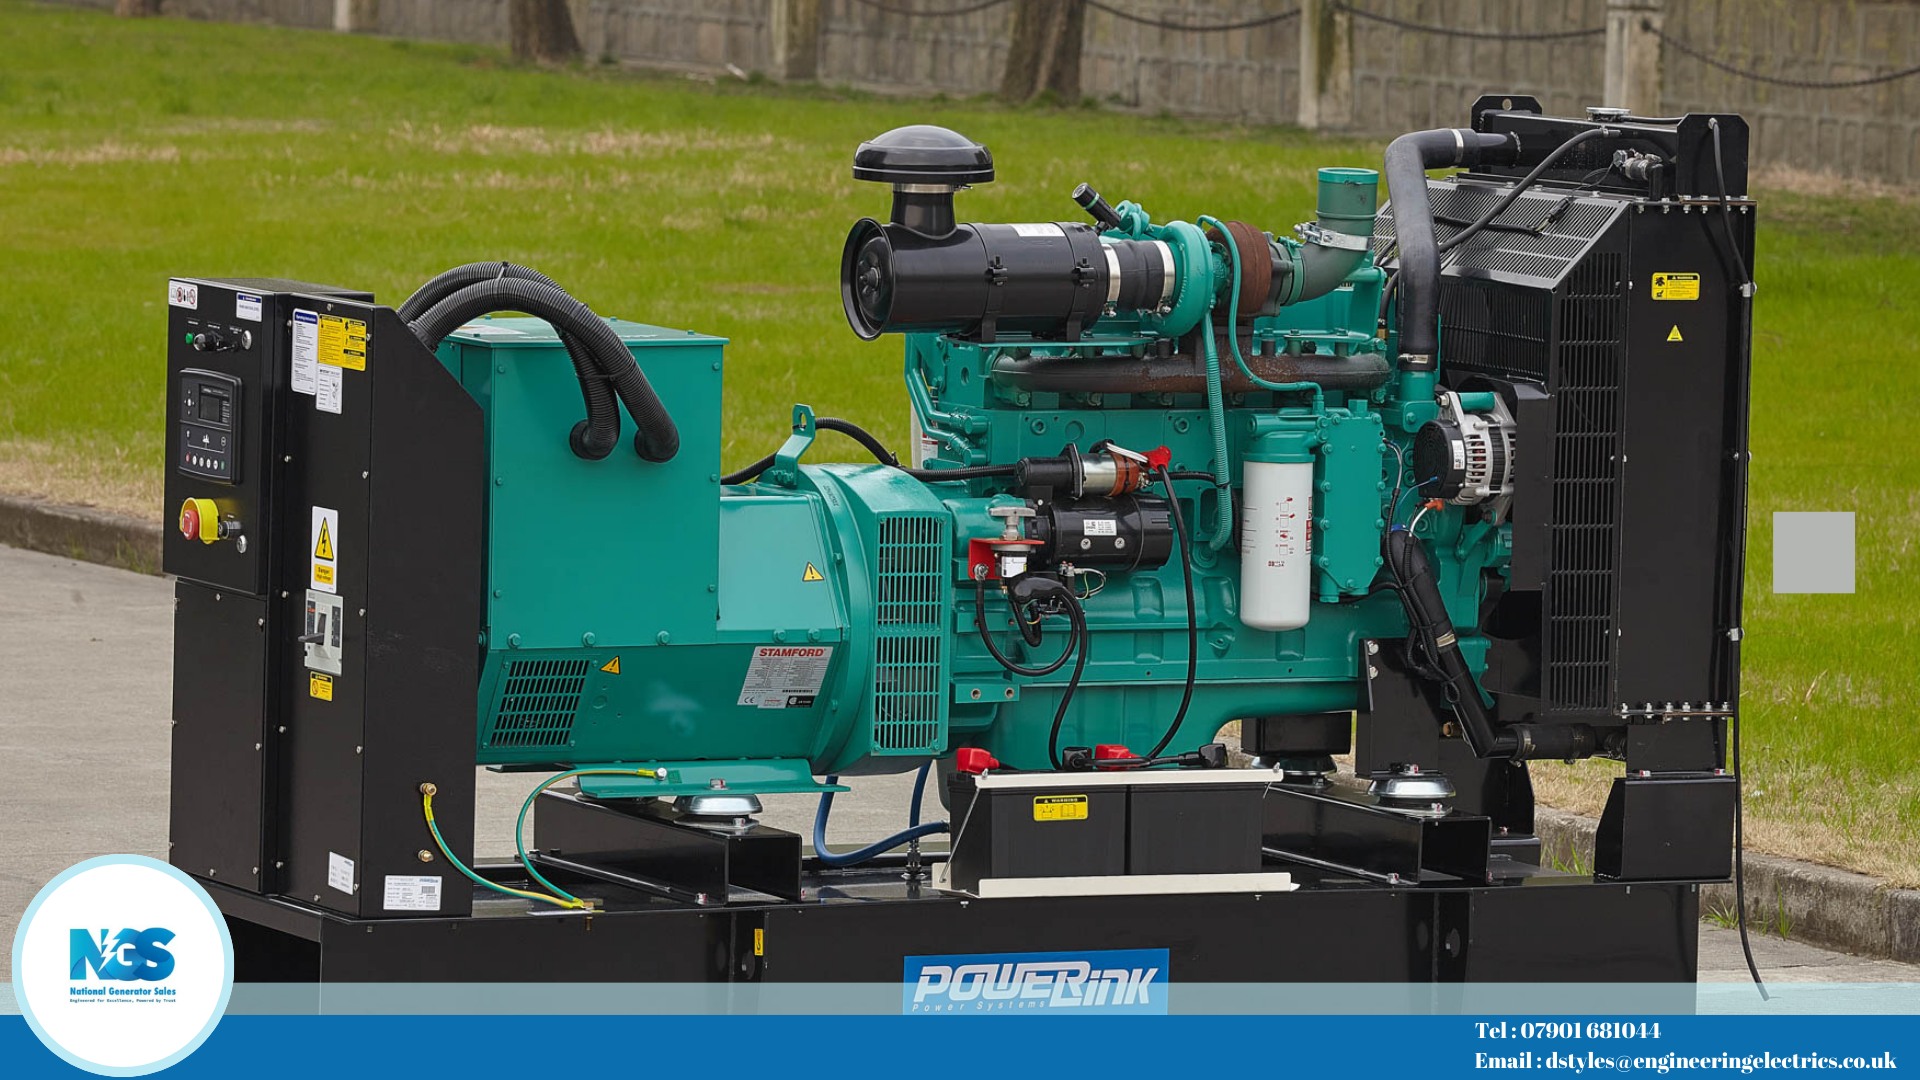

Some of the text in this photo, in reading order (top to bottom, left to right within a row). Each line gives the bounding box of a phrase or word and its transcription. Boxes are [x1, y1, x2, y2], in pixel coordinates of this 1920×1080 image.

[759, 648, 824, 657] STAMFORD
[912, 1000, 1045, 1012] Power Systems
